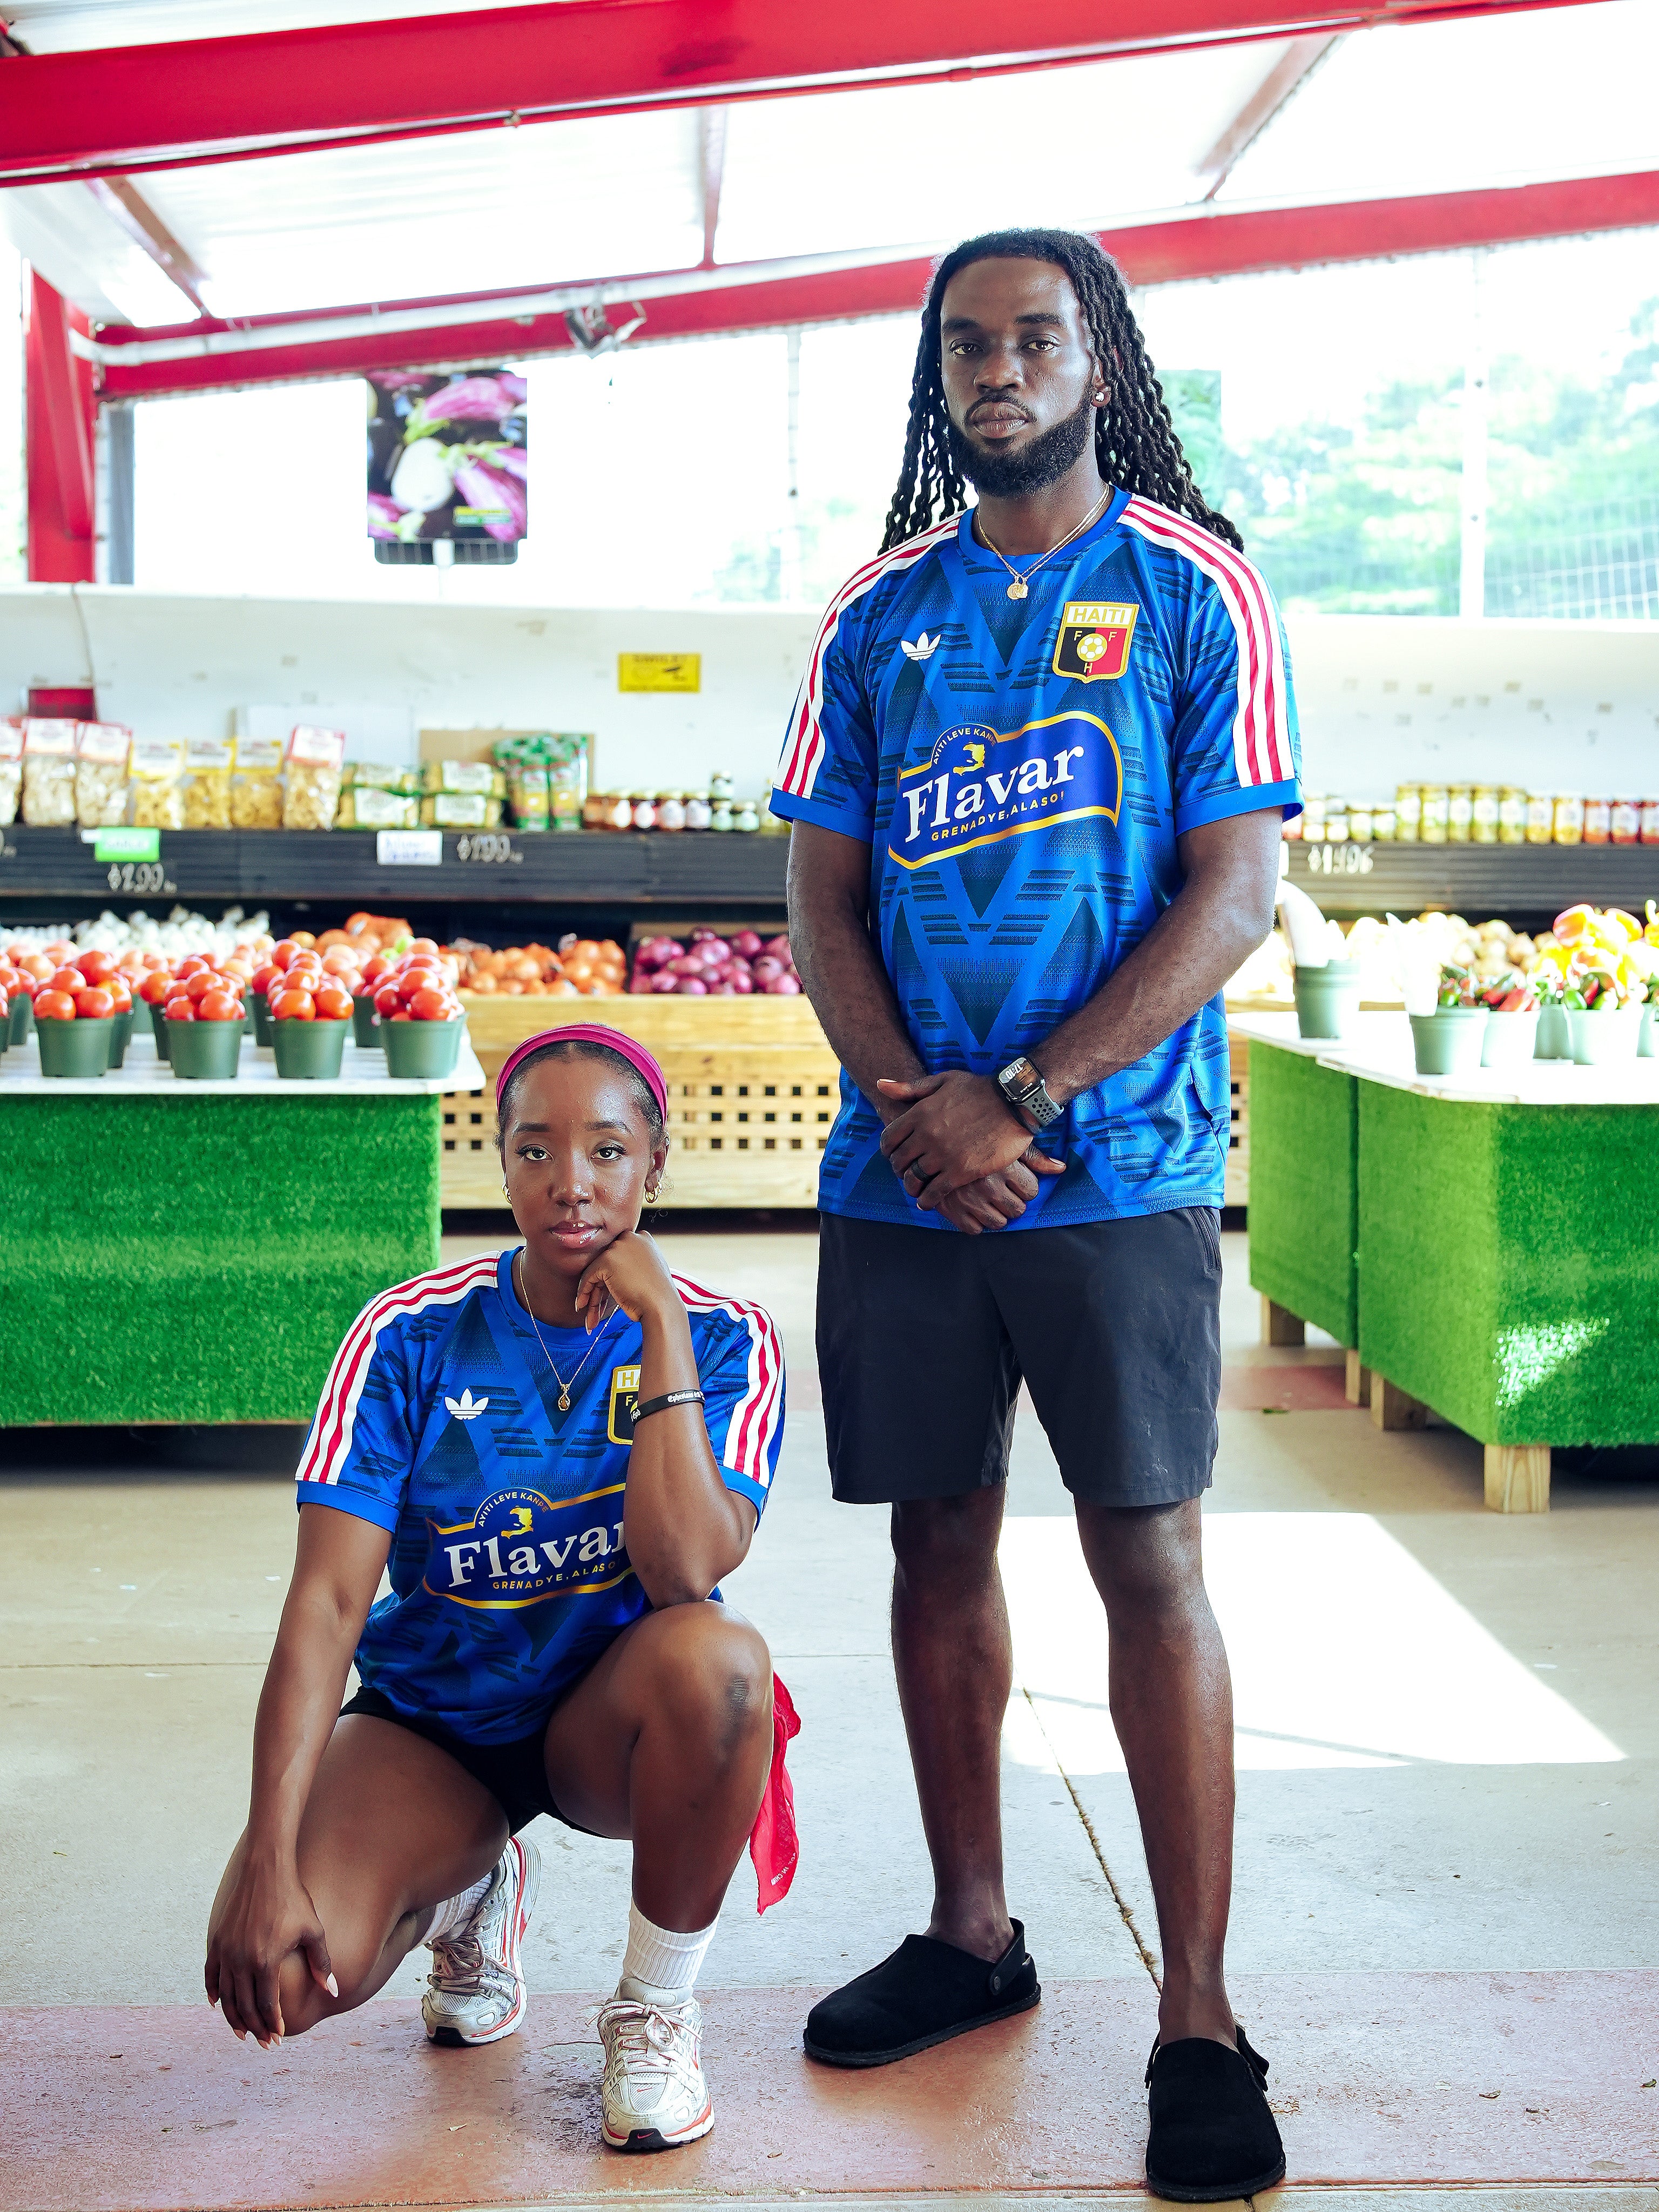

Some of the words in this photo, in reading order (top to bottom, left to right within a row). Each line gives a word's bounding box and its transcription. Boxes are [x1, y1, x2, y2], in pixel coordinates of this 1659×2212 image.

[1073, 608, 1125, 623] HAITI
[1074, 630, 1083, 641] F
[1108, 631, 1117, 642] F
[1083, 662, 1093, 673] H
[933, 739, 947, 765] AYITI
[947, 727, 971, 741] LEVE
[902, 746, 1084, 843] Flavar
[625, 1395, 633, 1406] F
[478, 1502, 494, 1527] AYITI
[493, 1492, 517, 1505] LEVE
